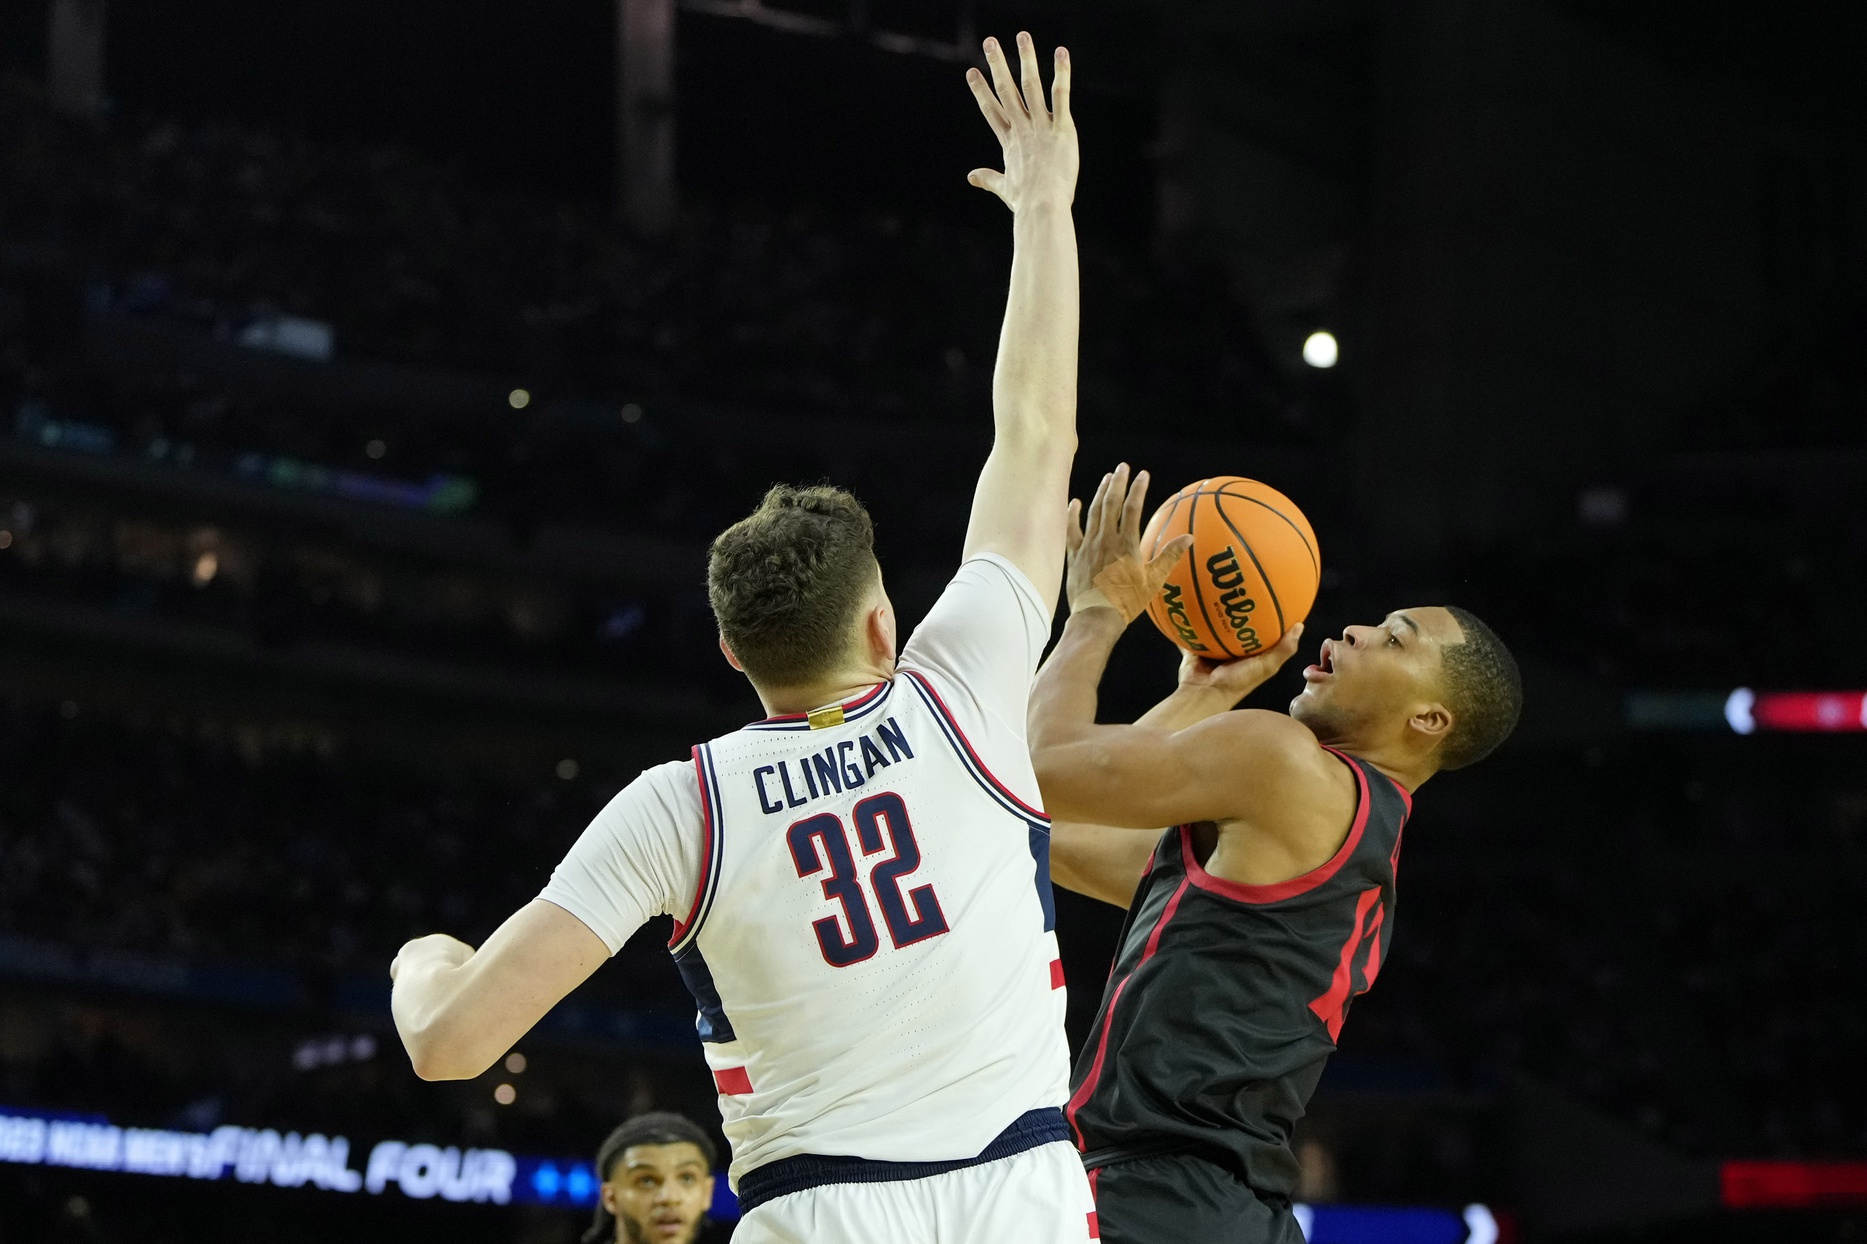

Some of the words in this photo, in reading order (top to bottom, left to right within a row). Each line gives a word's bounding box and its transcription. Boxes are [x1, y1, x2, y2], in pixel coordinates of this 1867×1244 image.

[1162, 582, 1210, 652] NCAA
[1206, 545, 1263, 654] Wilson
[753, 716, 915, 815] CLINGAN
[785, 791, 950, 968] 32
[208, 1125, 363, 1193] FINAL
[365, 1140, 517, 1205] FOUR
